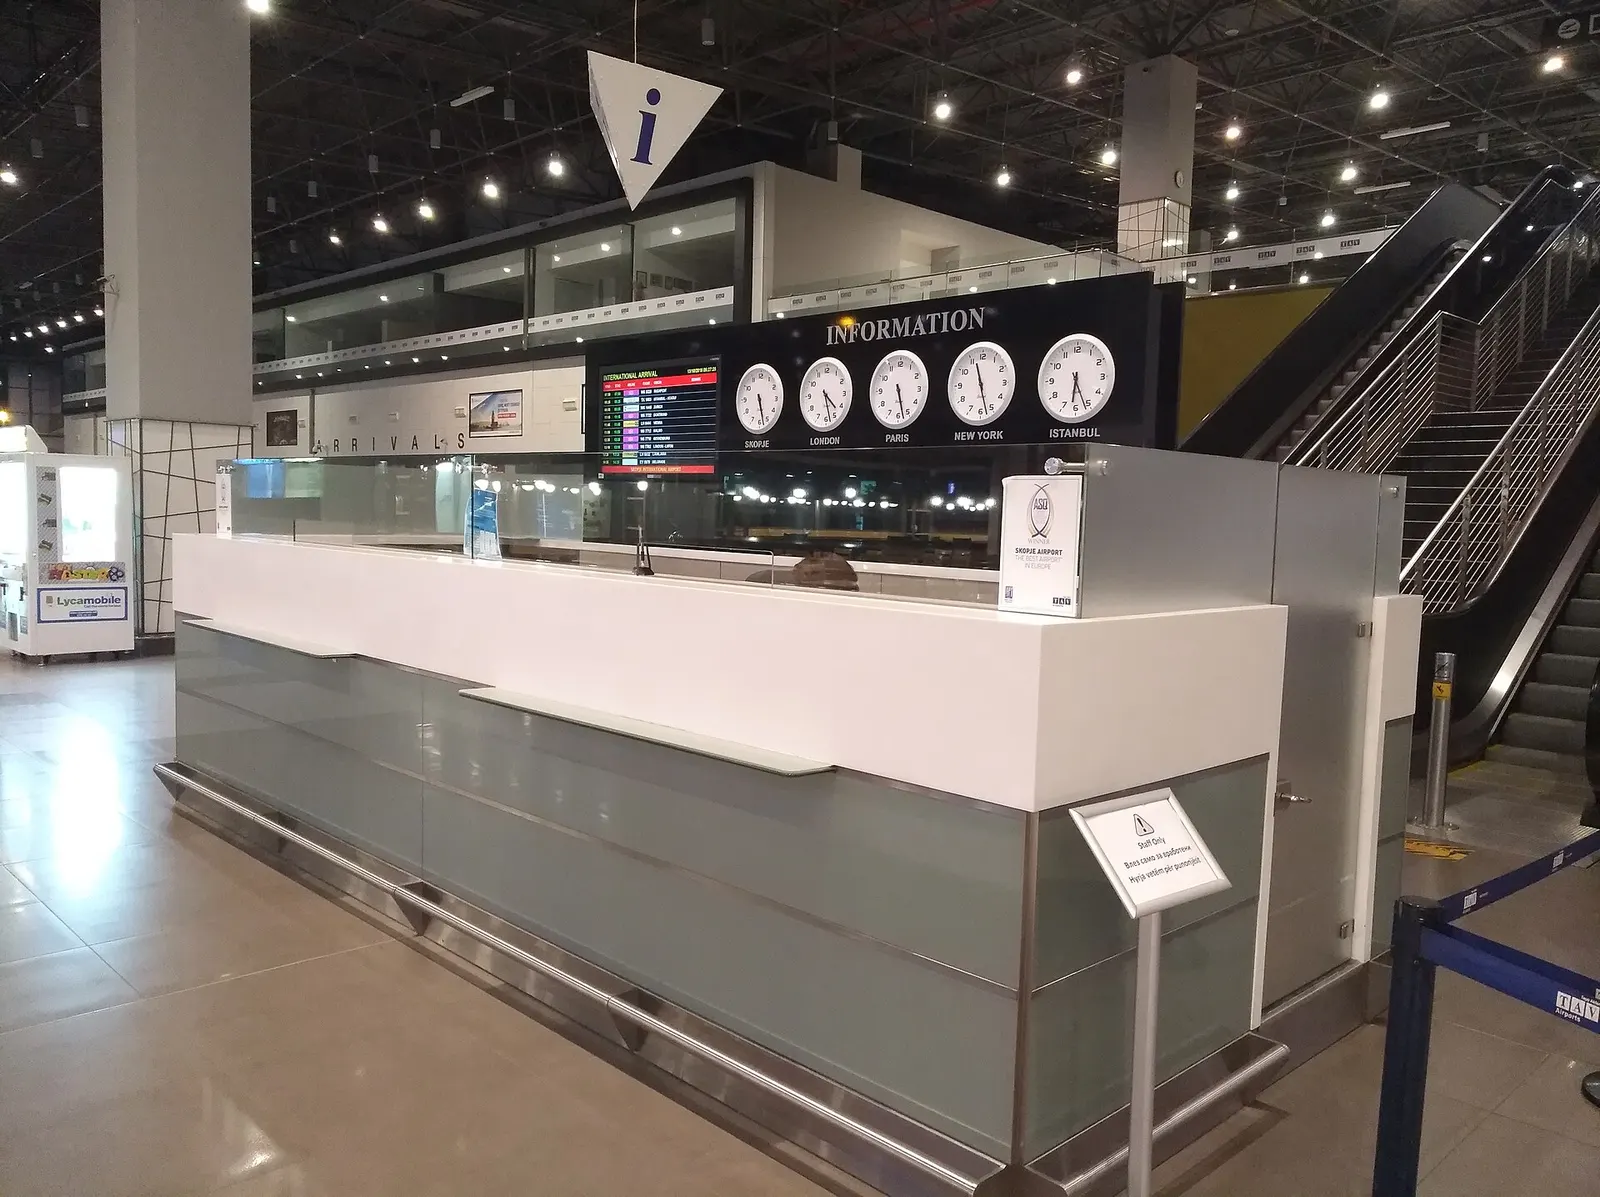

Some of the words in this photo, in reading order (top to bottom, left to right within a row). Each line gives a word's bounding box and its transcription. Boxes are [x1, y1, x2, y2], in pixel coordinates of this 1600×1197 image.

[630, 88, 661, 165] i
[826, 306, 986, 346] INFORMATION
[603, 372, 638, 381] INTERNATIONAL
[638, 371, 658, 379] ARRIVAL
[885, 434, 909, 443] PARIS
[954, 431, 976, 440] NEW
[977, 430, 1003, 440] YORK
[1049, 428, 1100, 438] ISTANBUL
[316, 433, 465, 452] ARRIVALS
[745, 440, 769, 449] SKOPJE
[810, 437, 840, 446] LONDON
[1033, 498, 1048, 510] ASQ
[1015, 547, 1036, 555] SKOPJE
[1037, 548, 1062, 556] AIRPORT
[57, 595, 121, 607] Lycamobile
[1138, 839, 1153, 850] Staff
[1152, 836, 1166, 845] Only
[1124, 860, 1140, 869] Влез
[1140, 855, 1156, 864] само
[1155, 852, 1163, 860] за
[1128, 872, 1147, 883] Hyrja
[1557, 992, 1598, 1021] TAV
[1555, 1007, 1581, 1023] Airports
